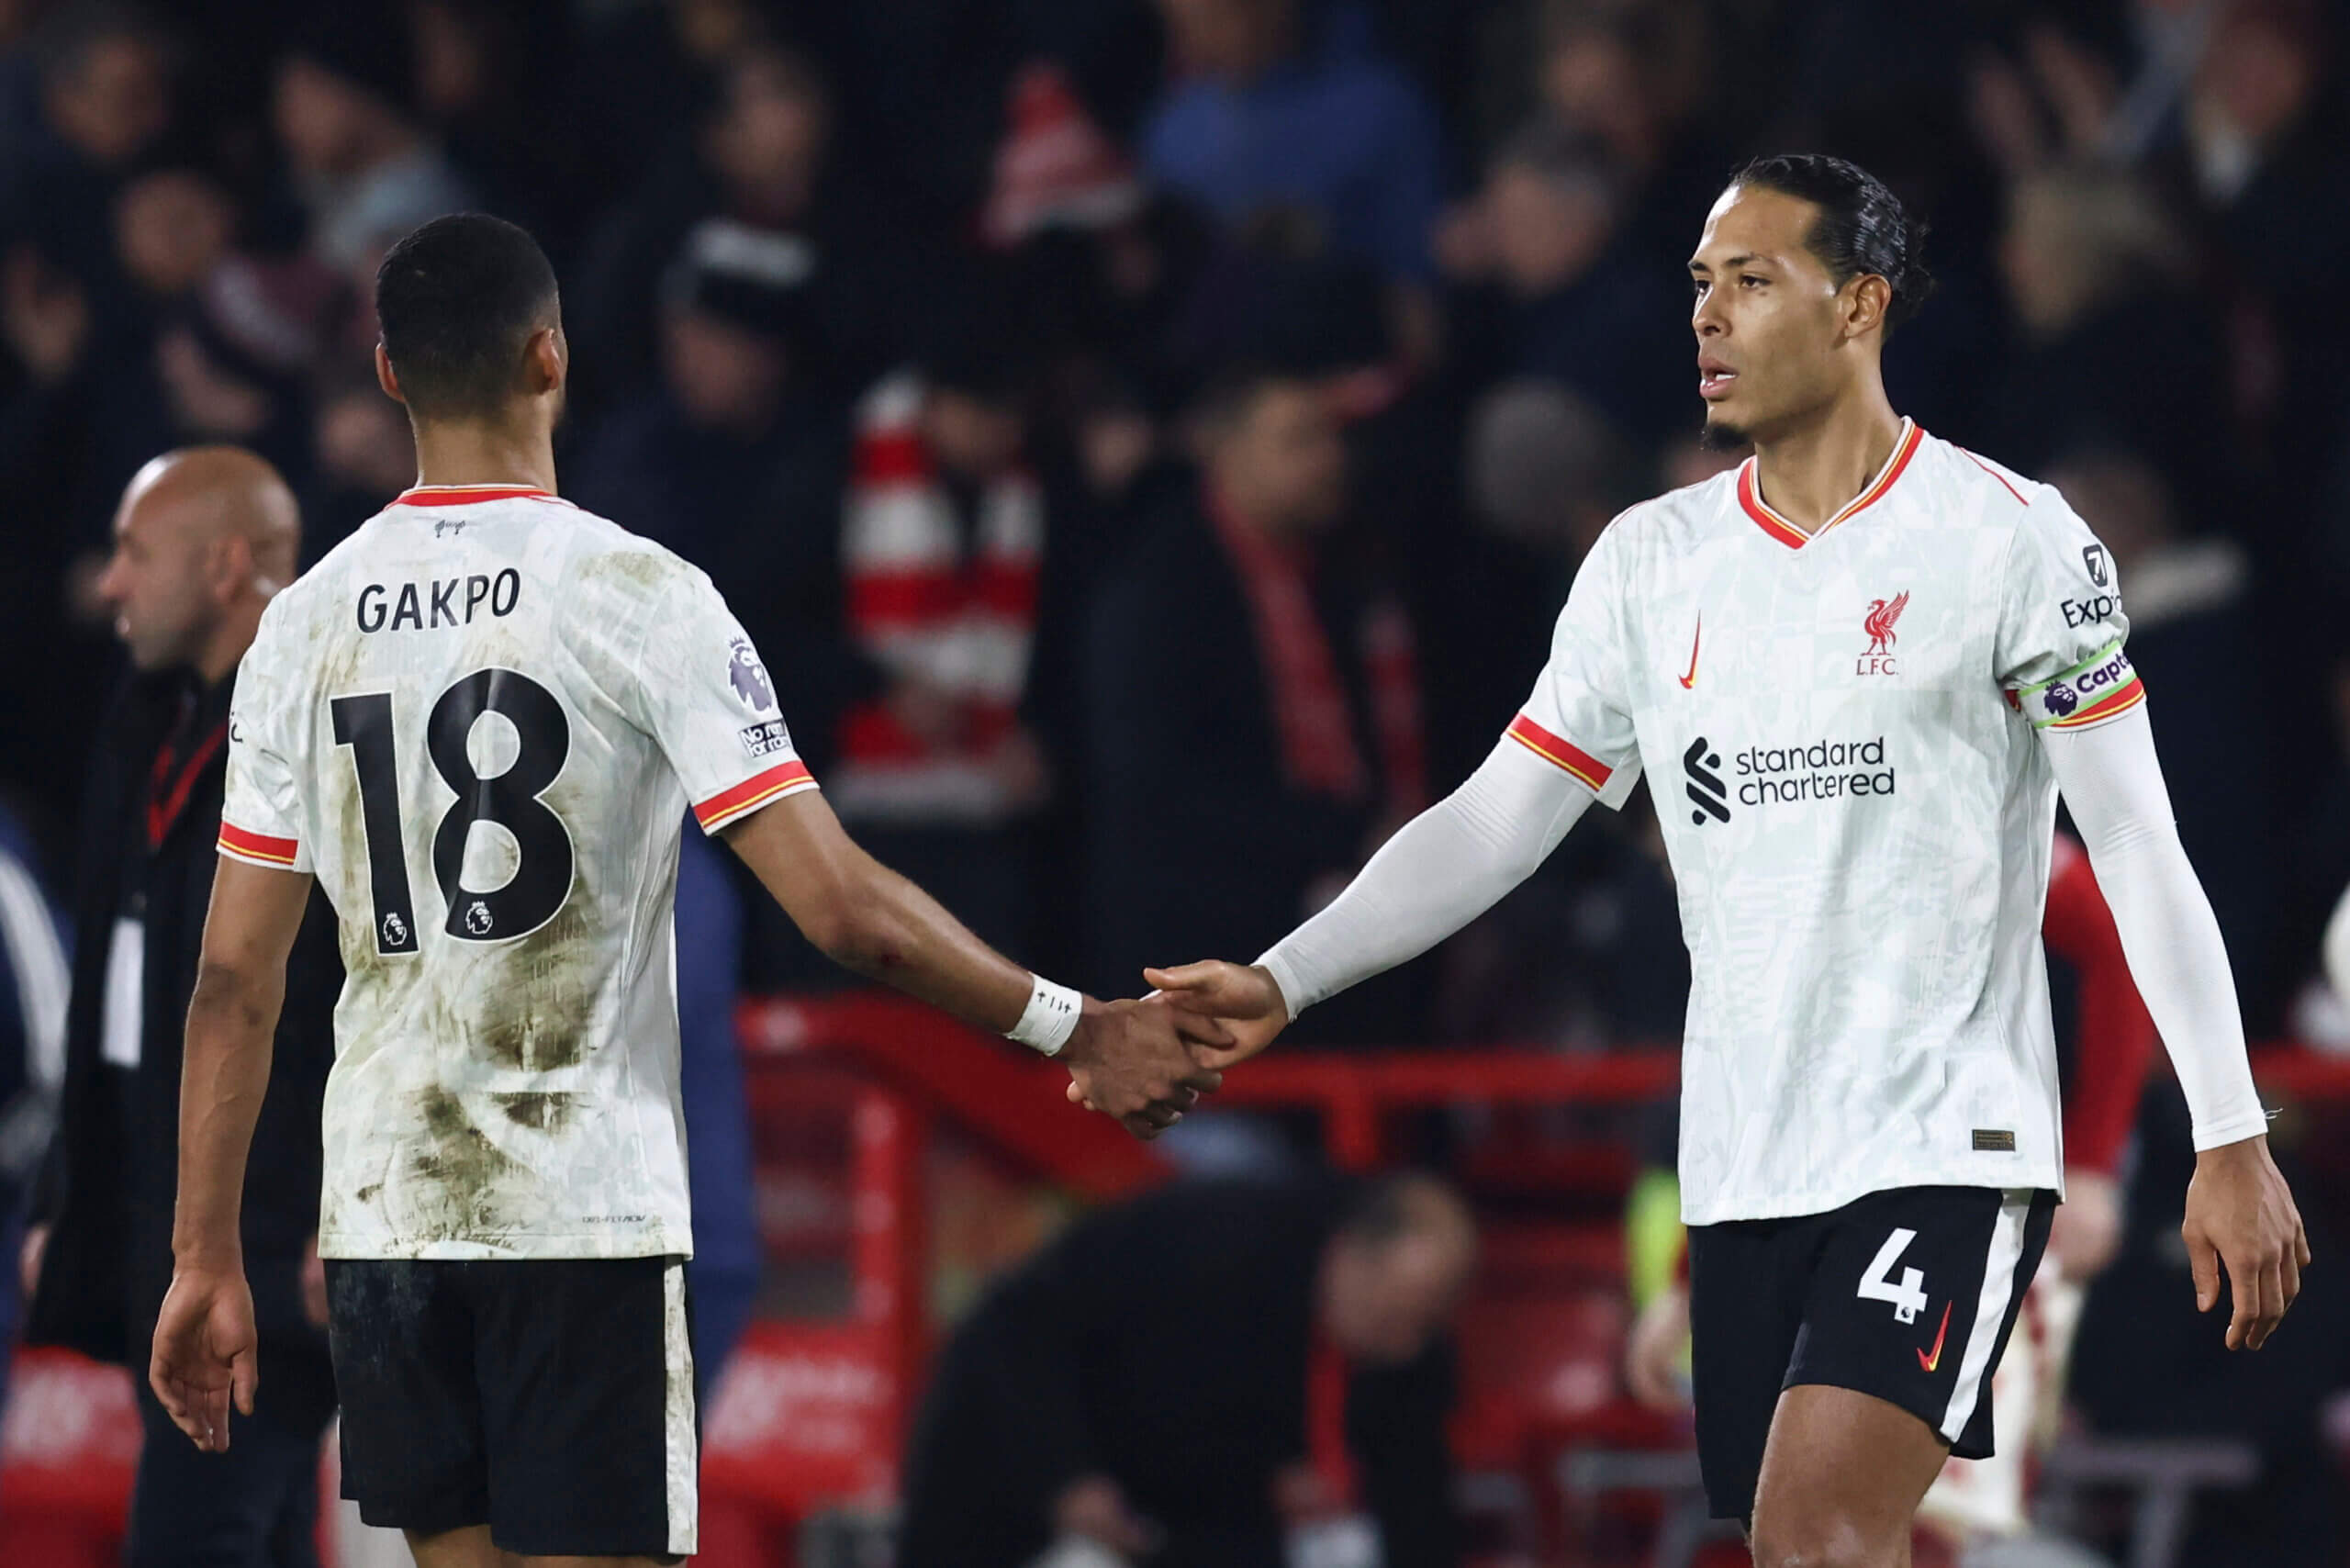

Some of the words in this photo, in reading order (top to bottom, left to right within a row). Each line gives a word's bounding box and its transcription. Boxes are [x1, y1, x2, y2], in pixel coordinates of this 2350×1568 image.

[357, 567, 520, 633] GAKPO
[1856, 658, 1899, 676] L.F.C.
[740, 728, 764, 745] No
[1737, 736, 1884, 775] standard
[1739, 767, 1895, 805] chartered
[330, 666, 576, 955] 18
[1857, 1227, 1928, 1325] 4
